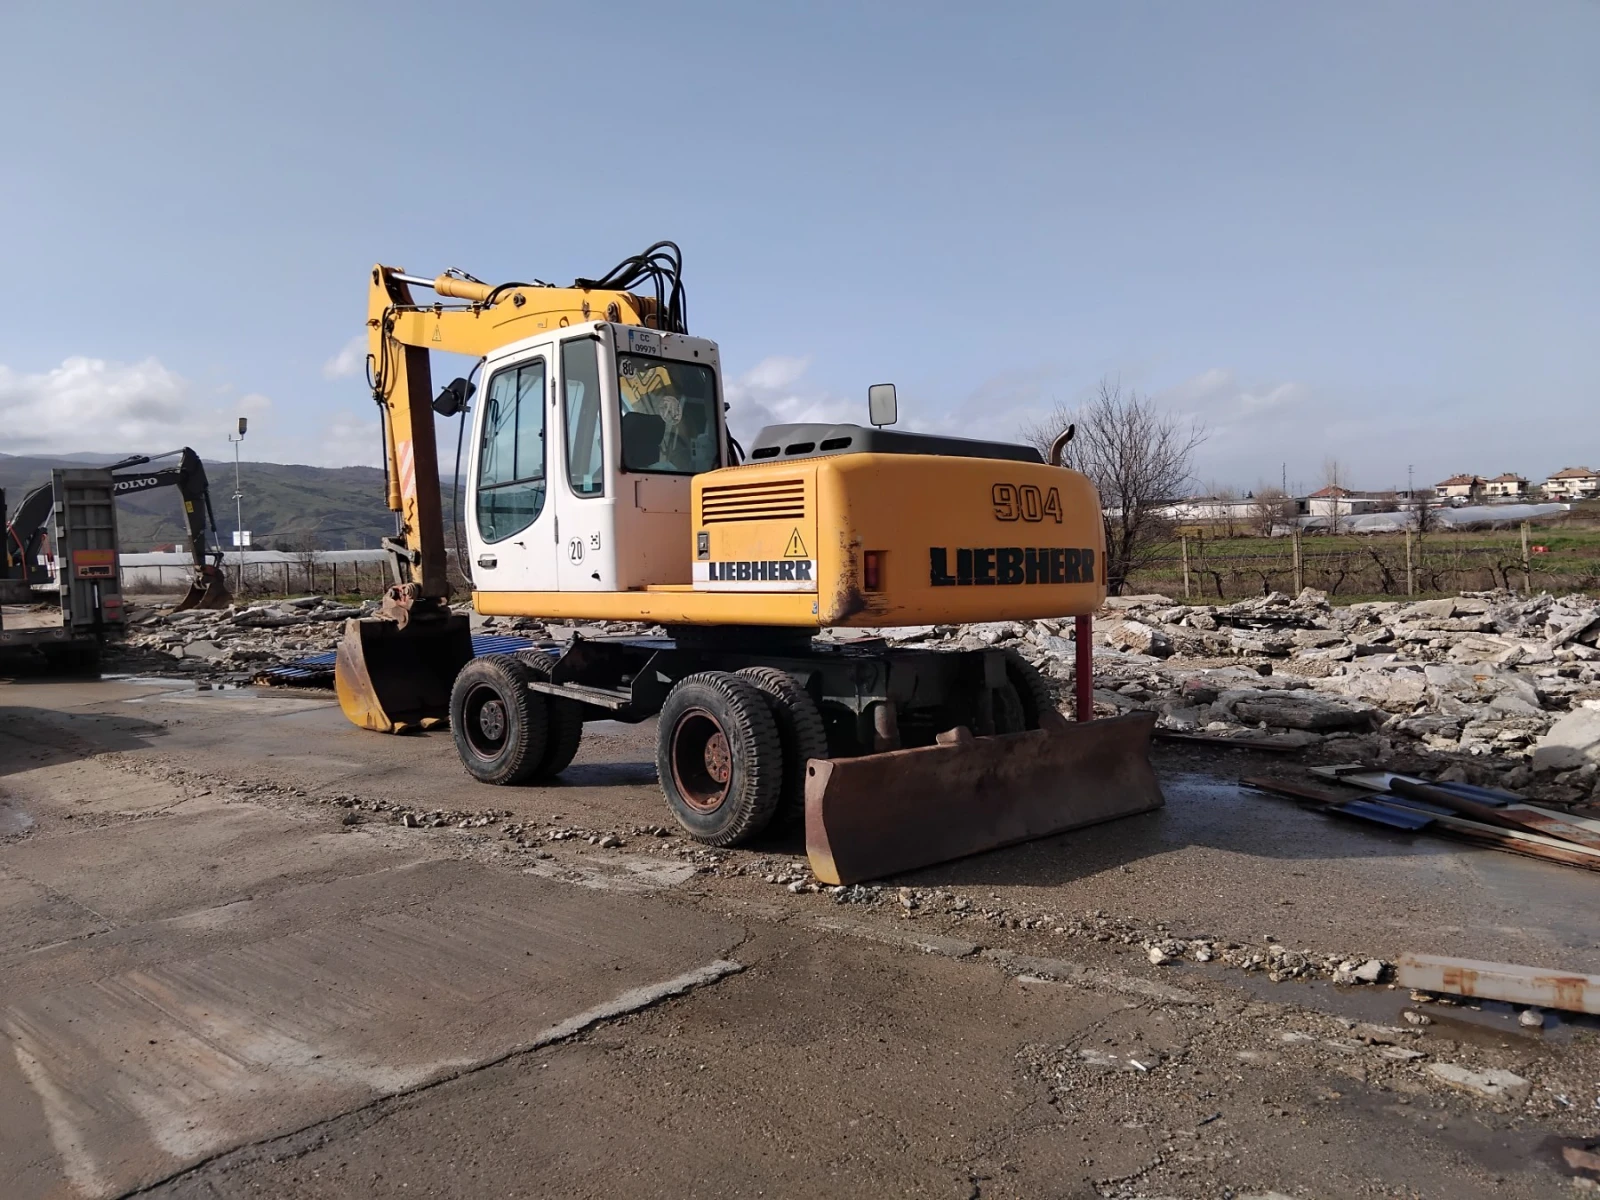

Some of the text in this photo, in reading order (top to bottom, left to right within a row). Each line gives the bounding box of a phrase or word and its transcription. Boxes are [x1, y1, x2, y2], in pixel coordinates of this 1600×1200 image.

[635, 344, 656, 354] 09979
[622, 361, 634, 375] 80
[992, 483, 1063, 524] 904
[570, 541, 583, 560] 20
[708, 560, 812, 581] LIEBHERR
[930, 547, 1095, 587] LIEBHERR
